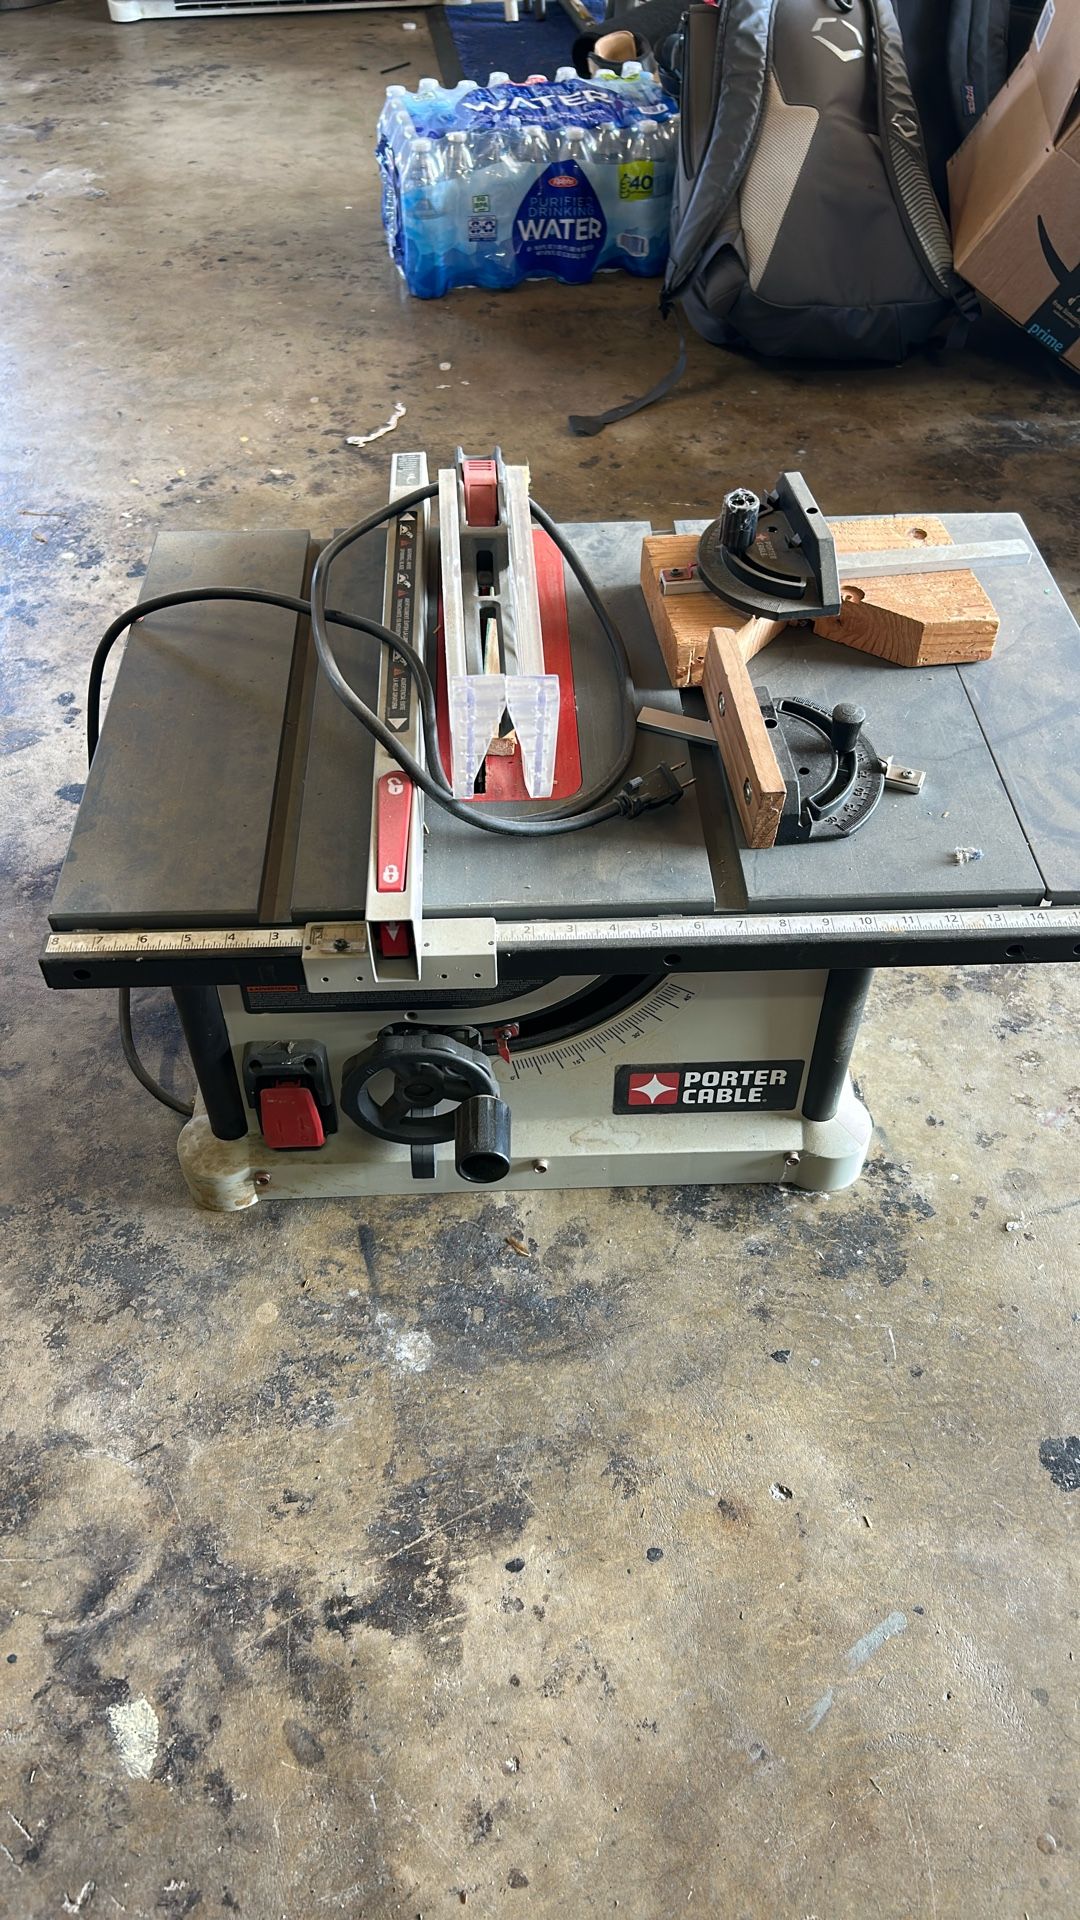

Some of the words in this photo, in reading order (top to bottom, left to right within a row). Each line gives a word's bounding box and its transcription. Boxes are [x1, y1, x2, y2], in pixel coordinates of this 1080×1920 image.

[462, 90, 613, 112] WATER
[630, 175, 653, 190] 40
[528, 206, 595, 217] DRINKING
[517, 217, 602, 241] WATER
[1027, 323, 1064, 352] prime
[523, 925, 531, 934] 2
[566, 925, 574, 933] 3
[609, 924, 617, 932] 4
[651, 922, 659, 931] 5
[694, 921, 702, 930] 6
[736, 920, 744, 929] 7
[779, 919, 787, 928] 8
[822, 917, 830, 926] 9
[859, 917, 873, 925] 10
[902, 915, 915, 925] 11
[944, 914, 958, 924] 12
[987, 913, 1001, 922] 13
[1030, 912, 1044, 921] 14
[96, 936, 104, 944] 7
[140, 935, 148, 943] 6
[184, 934, 192, 942] 5
[227, 933, 235, 941] 4
[271, 932, 279, 940] 3
[683, 1069, 788, 1088] PORTER
[682, 1087, 763, 1104] CABLE
